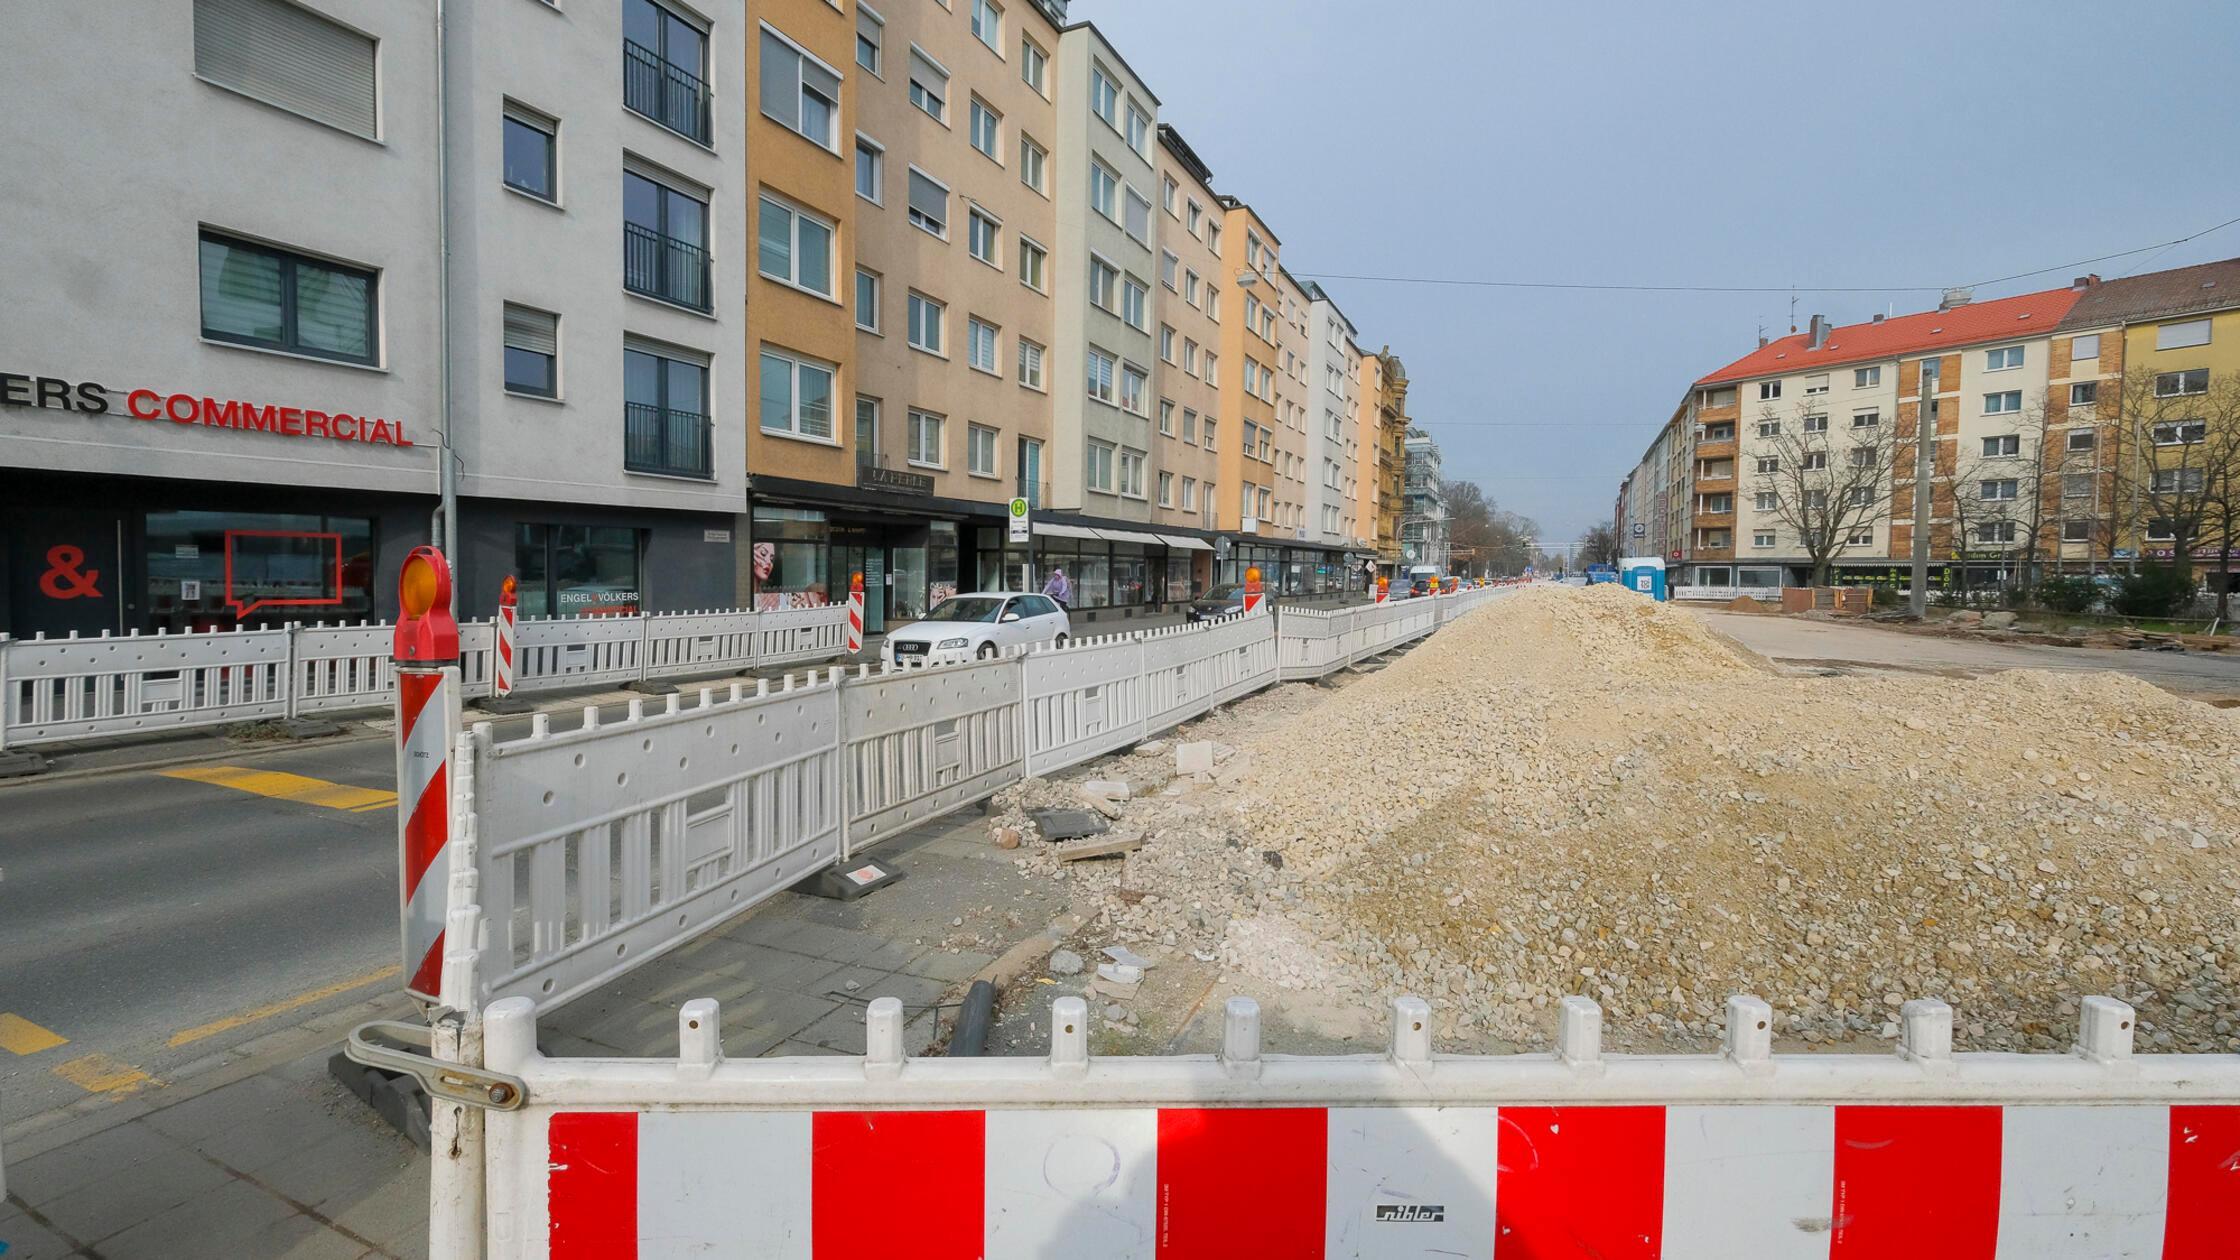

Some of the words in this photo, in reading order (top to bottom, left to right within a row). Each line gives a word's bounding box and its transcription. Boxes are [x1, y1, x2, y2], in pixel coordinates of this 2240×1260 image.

[127, 389, 413, 447] COMMERCIAL
[1014, 503, 1022, 513] H
[39, 544, 104, 600] &
[560, 593, 592, 603] ENGEL
[598, 592, 640, 602] VÖLKERS
[1378, 1205, 1444, 1222] nibler
